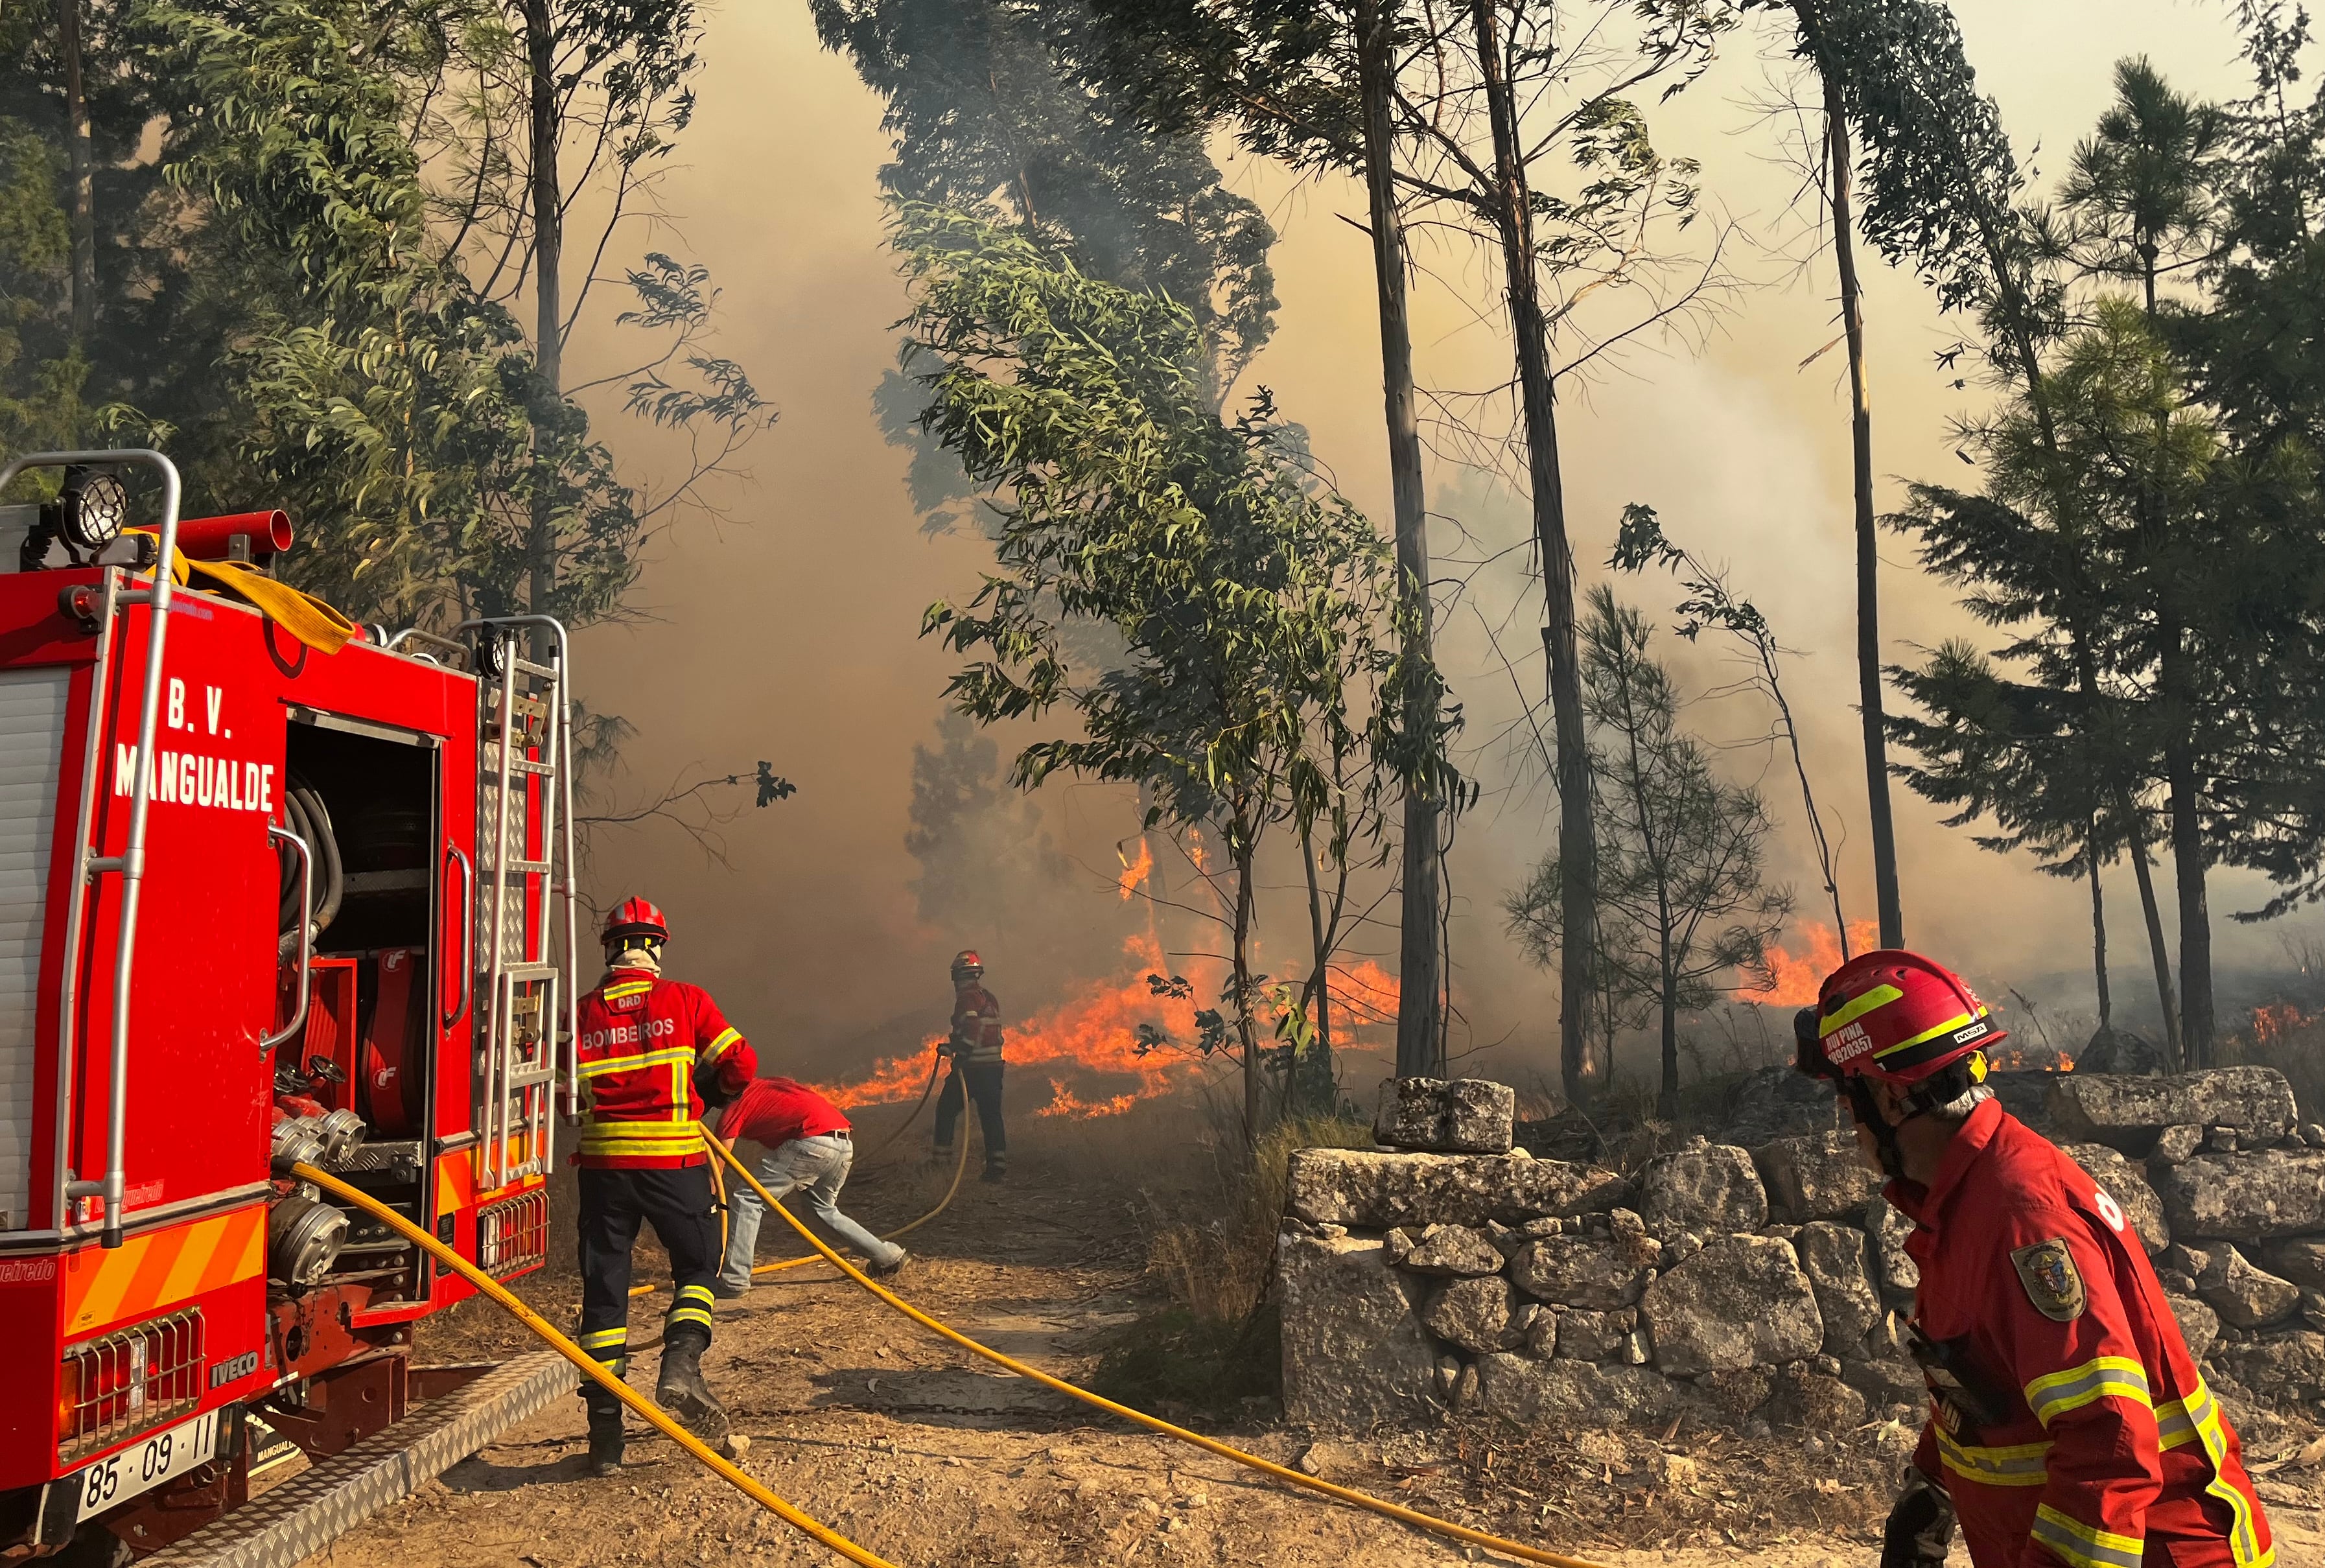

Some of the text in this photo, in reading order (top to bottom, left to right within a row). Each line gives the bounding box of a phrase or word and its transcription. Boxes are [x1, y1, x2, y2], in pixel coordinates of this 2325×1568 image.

[168, 677, 231, 739] B. V.
[618, 995, 641, 1009] DRD
[582, 1018, 674, 1050] BOMBEIROS
[1825, 1022, 1864, 1052] RUI PINA
[1957, 1026, 1984, 1040] MSA
[210, 1351, 258, 1389] IVECO
[87, 1455, 121, 1508] 85
[143, 1434, 172, 1482] 09
